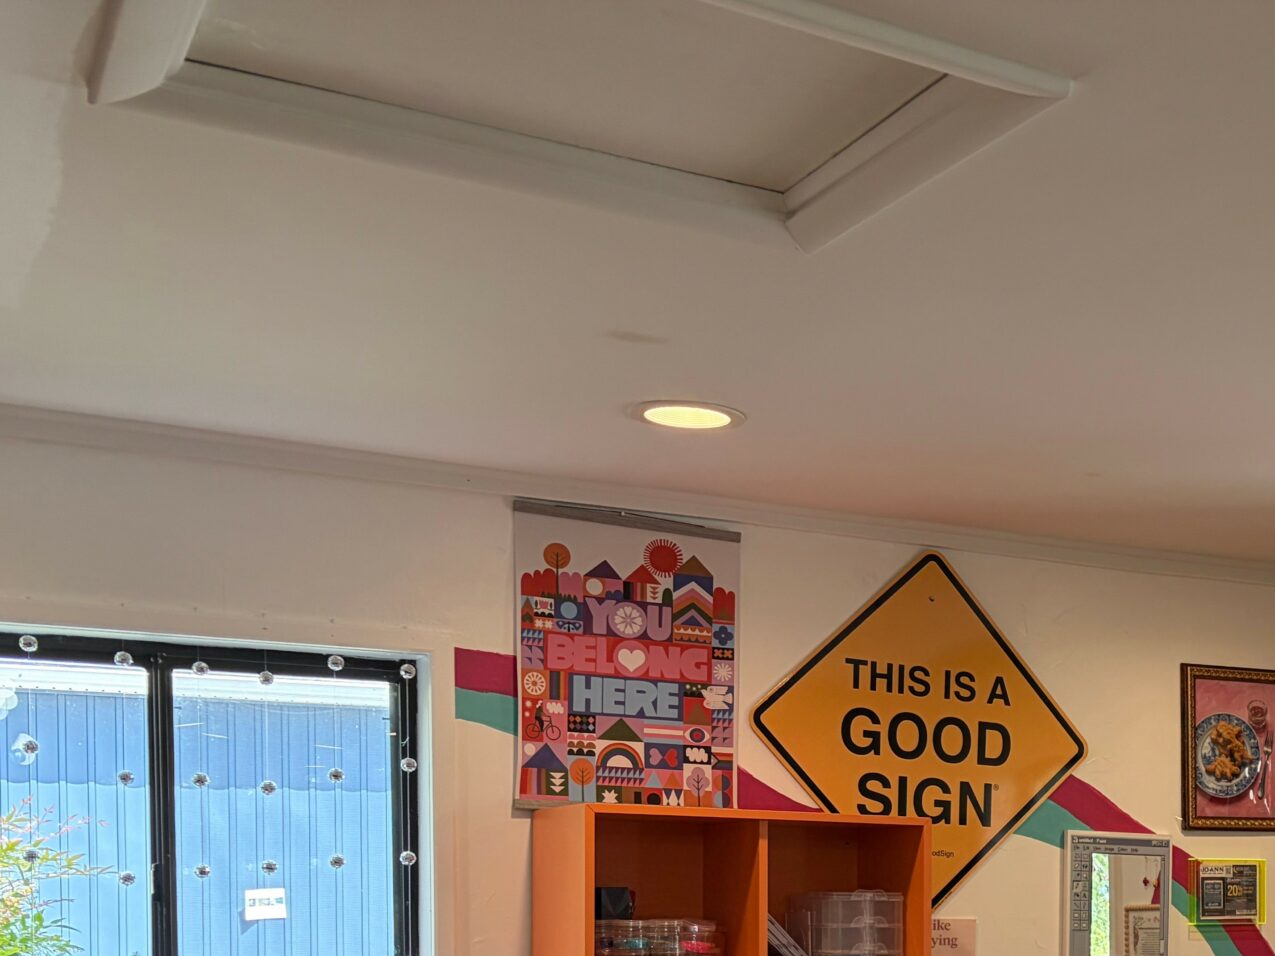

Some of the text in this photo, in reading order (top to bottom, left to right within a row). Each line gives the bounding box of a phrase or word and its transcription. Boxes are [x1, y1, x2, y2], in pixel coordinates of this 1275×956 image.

[585, 597, 673, 642] YOU
[547, 634, 709, 681] BELONG
[572, 675, 679, 719] HERE
[845, 657, 1011, 707] THIS IS A
[840, 707, 1011, 766] GOOD
